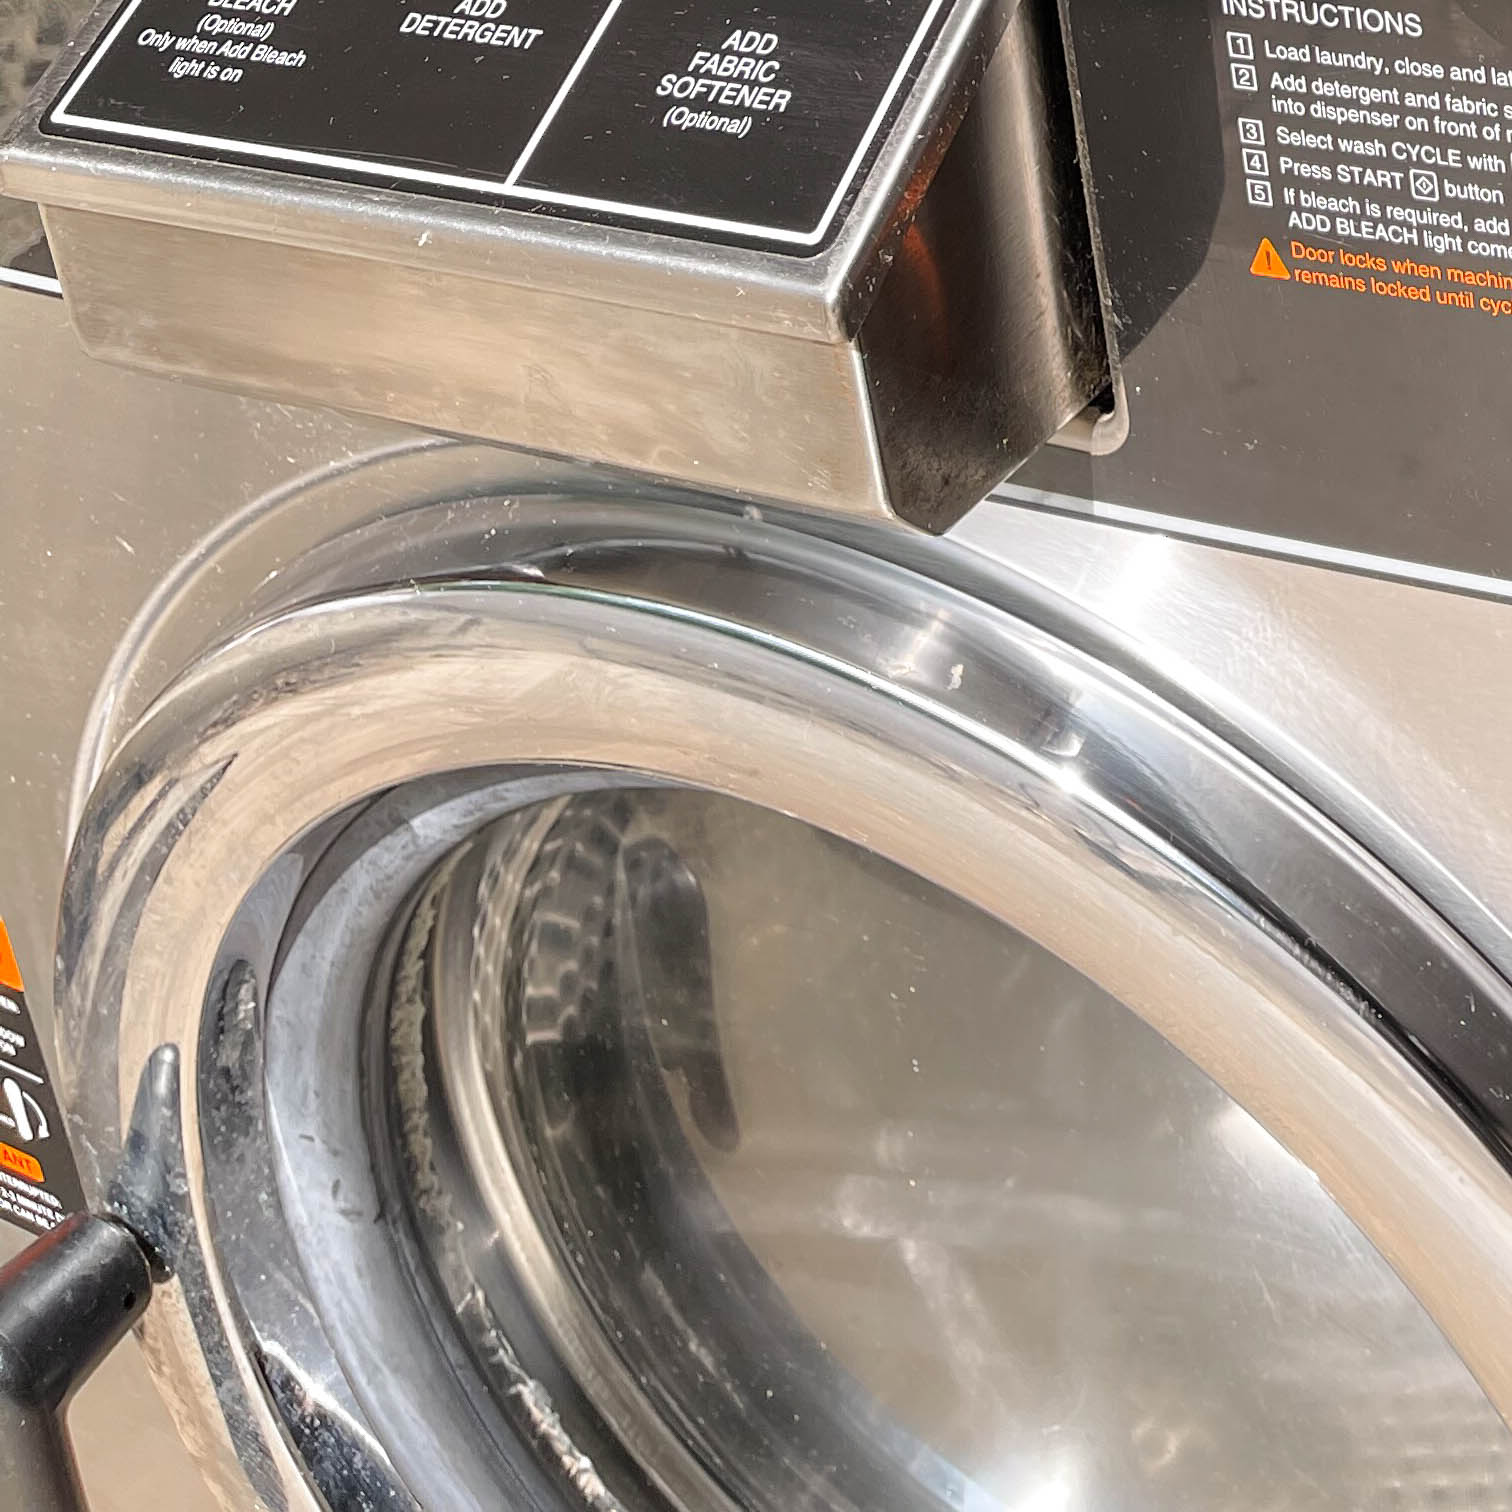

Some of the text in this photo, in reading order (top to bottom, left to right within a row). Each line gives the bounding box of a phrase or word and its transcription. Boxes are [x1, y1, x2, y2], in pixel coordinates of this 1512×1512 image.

[196, 14, 274, 41] (Optional)
[400, 13, 542, 50] DETERGENT
[721, 29, 778, 53] ADD
[138, 28, 306, 67] Only when Add Bleach
[1236, 37, 1244, 53] 1
[1264, 40, 1310, 62] Load
[1315, 46, 1389, 75] laundry,
[1394, 57, 1444, 79] close
[1450, 66, 1486, 84] and
[168, 56, 243, 82] light is on
[688, 52, 780, 83] FABRIC
[657, 74, 791, 112] SOFTENER
[1238, 69, 1250, 85] 2
[1271, 72, 1307, 93] Add
[1311, 77, 1400, 105] detergent
[1404, 92, 1440, 110] and
[1444, 93, 1498, 117] fabric
[663, 106, 752, 138] (Optional)
[1246, 124, 1257, 140] 3
[1276, 126, 1334, 150] Select
[1338, 138, 1387, 157] wash
[1392, 141, 1462, 167] CYCLE
[1467, 153, 1506, 173] with
[1250, 155, 1504, 205] 4 Press START button
[1254, 185, 1265, 200] 5
[1284, 187, 1295, 205] If
[1300, 189, 1361, 214] bleach
[1365, 199, 1381, 217] is
[1386, 206, 1468, 232] required,
[1474, 216, 1510, 236] add
[1289, 211, 1331, 232] ADD
[1336, 217, 1418, 245] BLEACH
[1423, 230, 1463, 253] light
[1291, 241, 1335, 264] Door
[1340, 249, 1387, 271] locks
[1391, 258, 1441, 280] when
